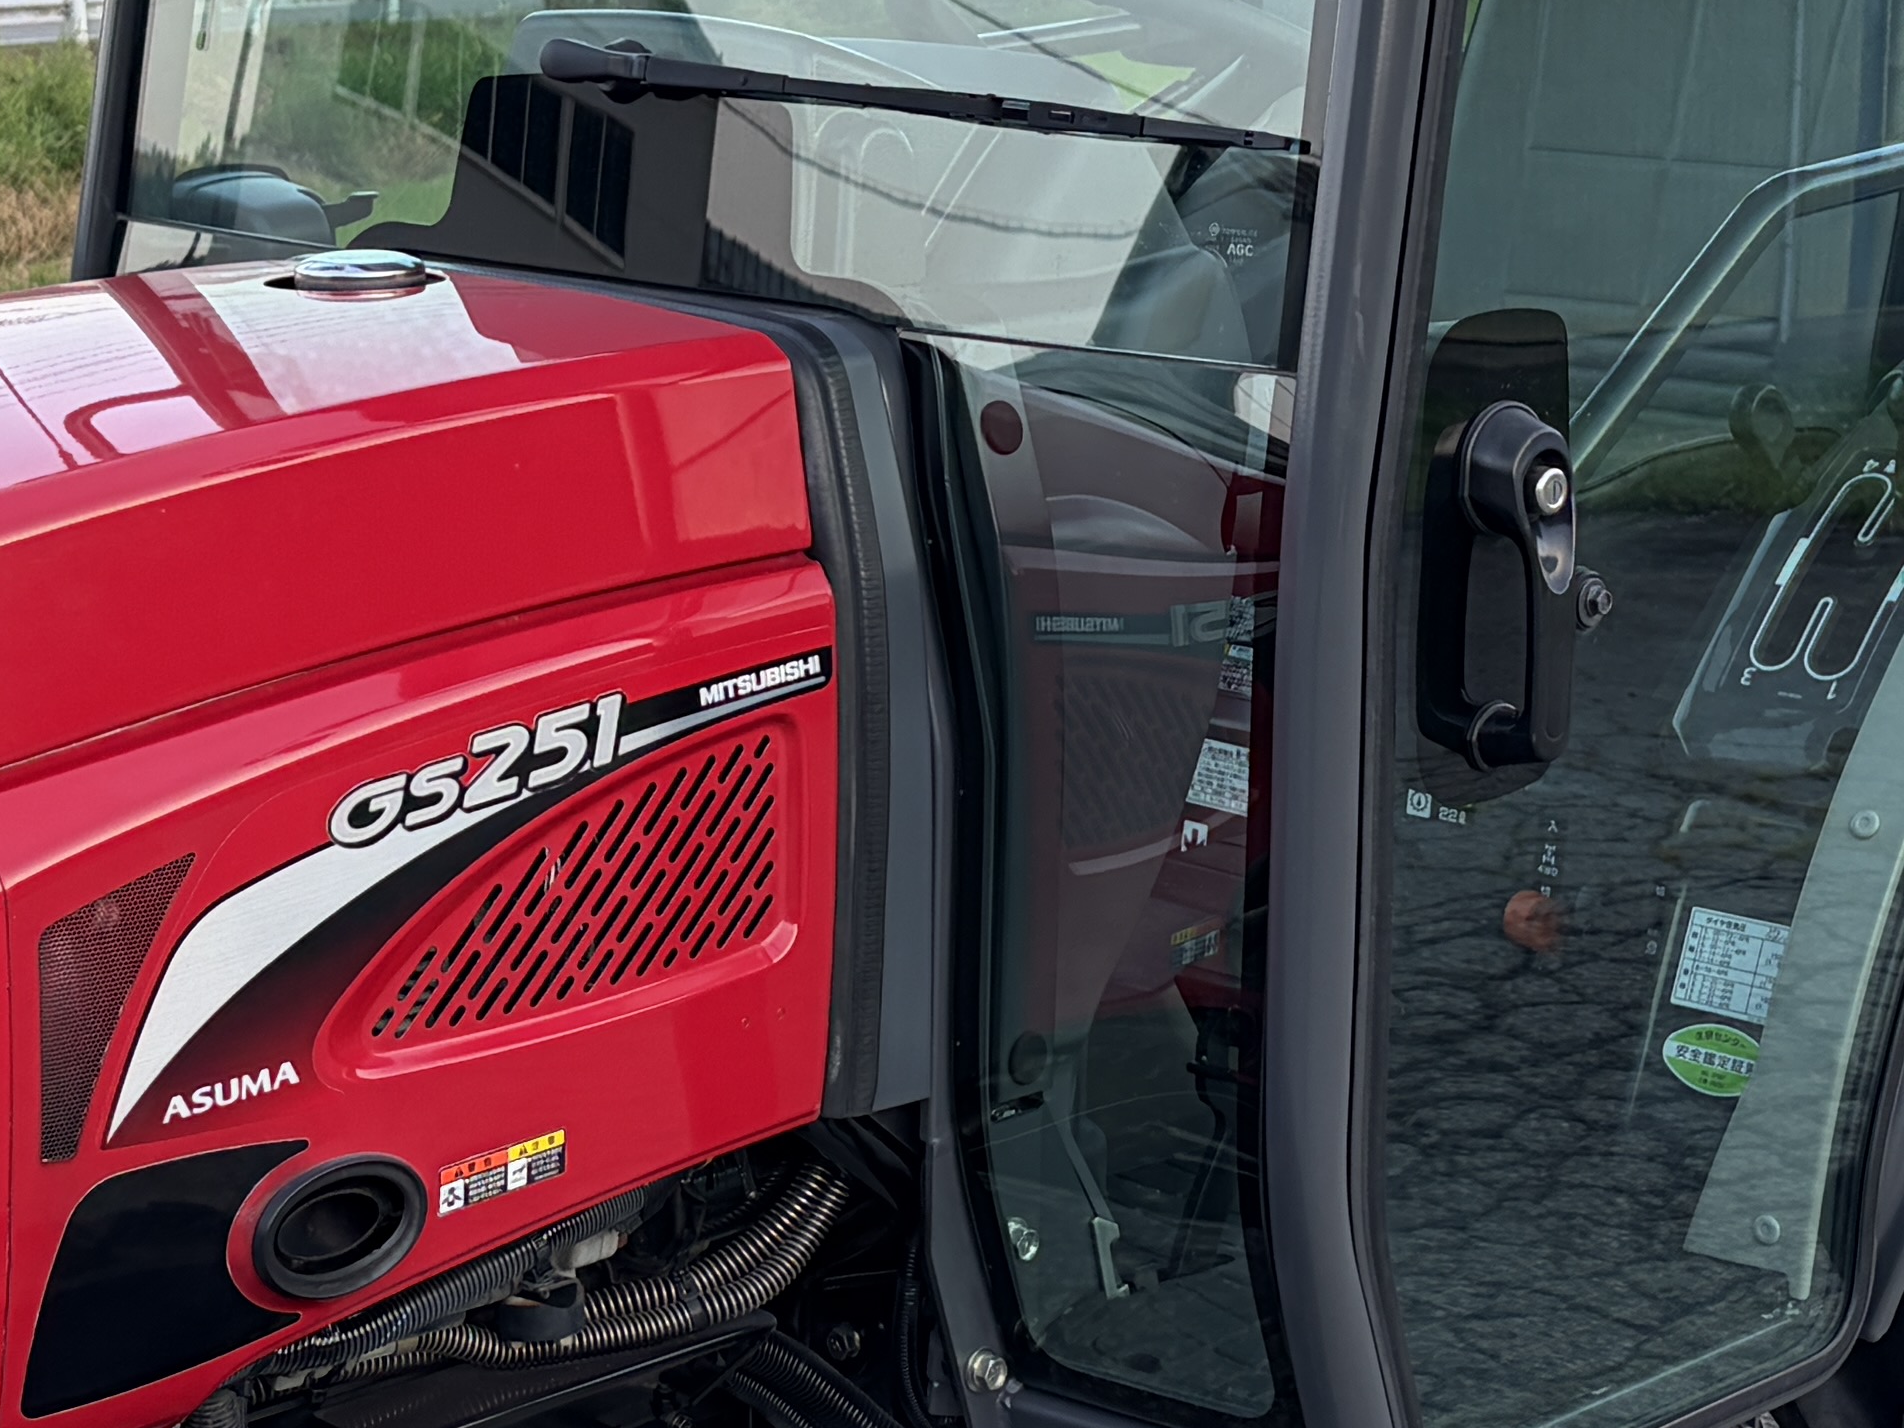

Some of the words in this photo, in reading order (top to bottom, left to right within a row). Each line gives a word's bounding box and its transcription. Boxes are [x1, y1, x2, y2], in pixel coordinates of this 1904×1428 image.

[1227, 244, 1254, 257] AGC
[699, 654, 821, 707] MITSUBISHI
[1740, 667, 1757, 685] 3
[327, 692, 624, 848] GS251
[162, 1061, 300, 1124] ASUMA
